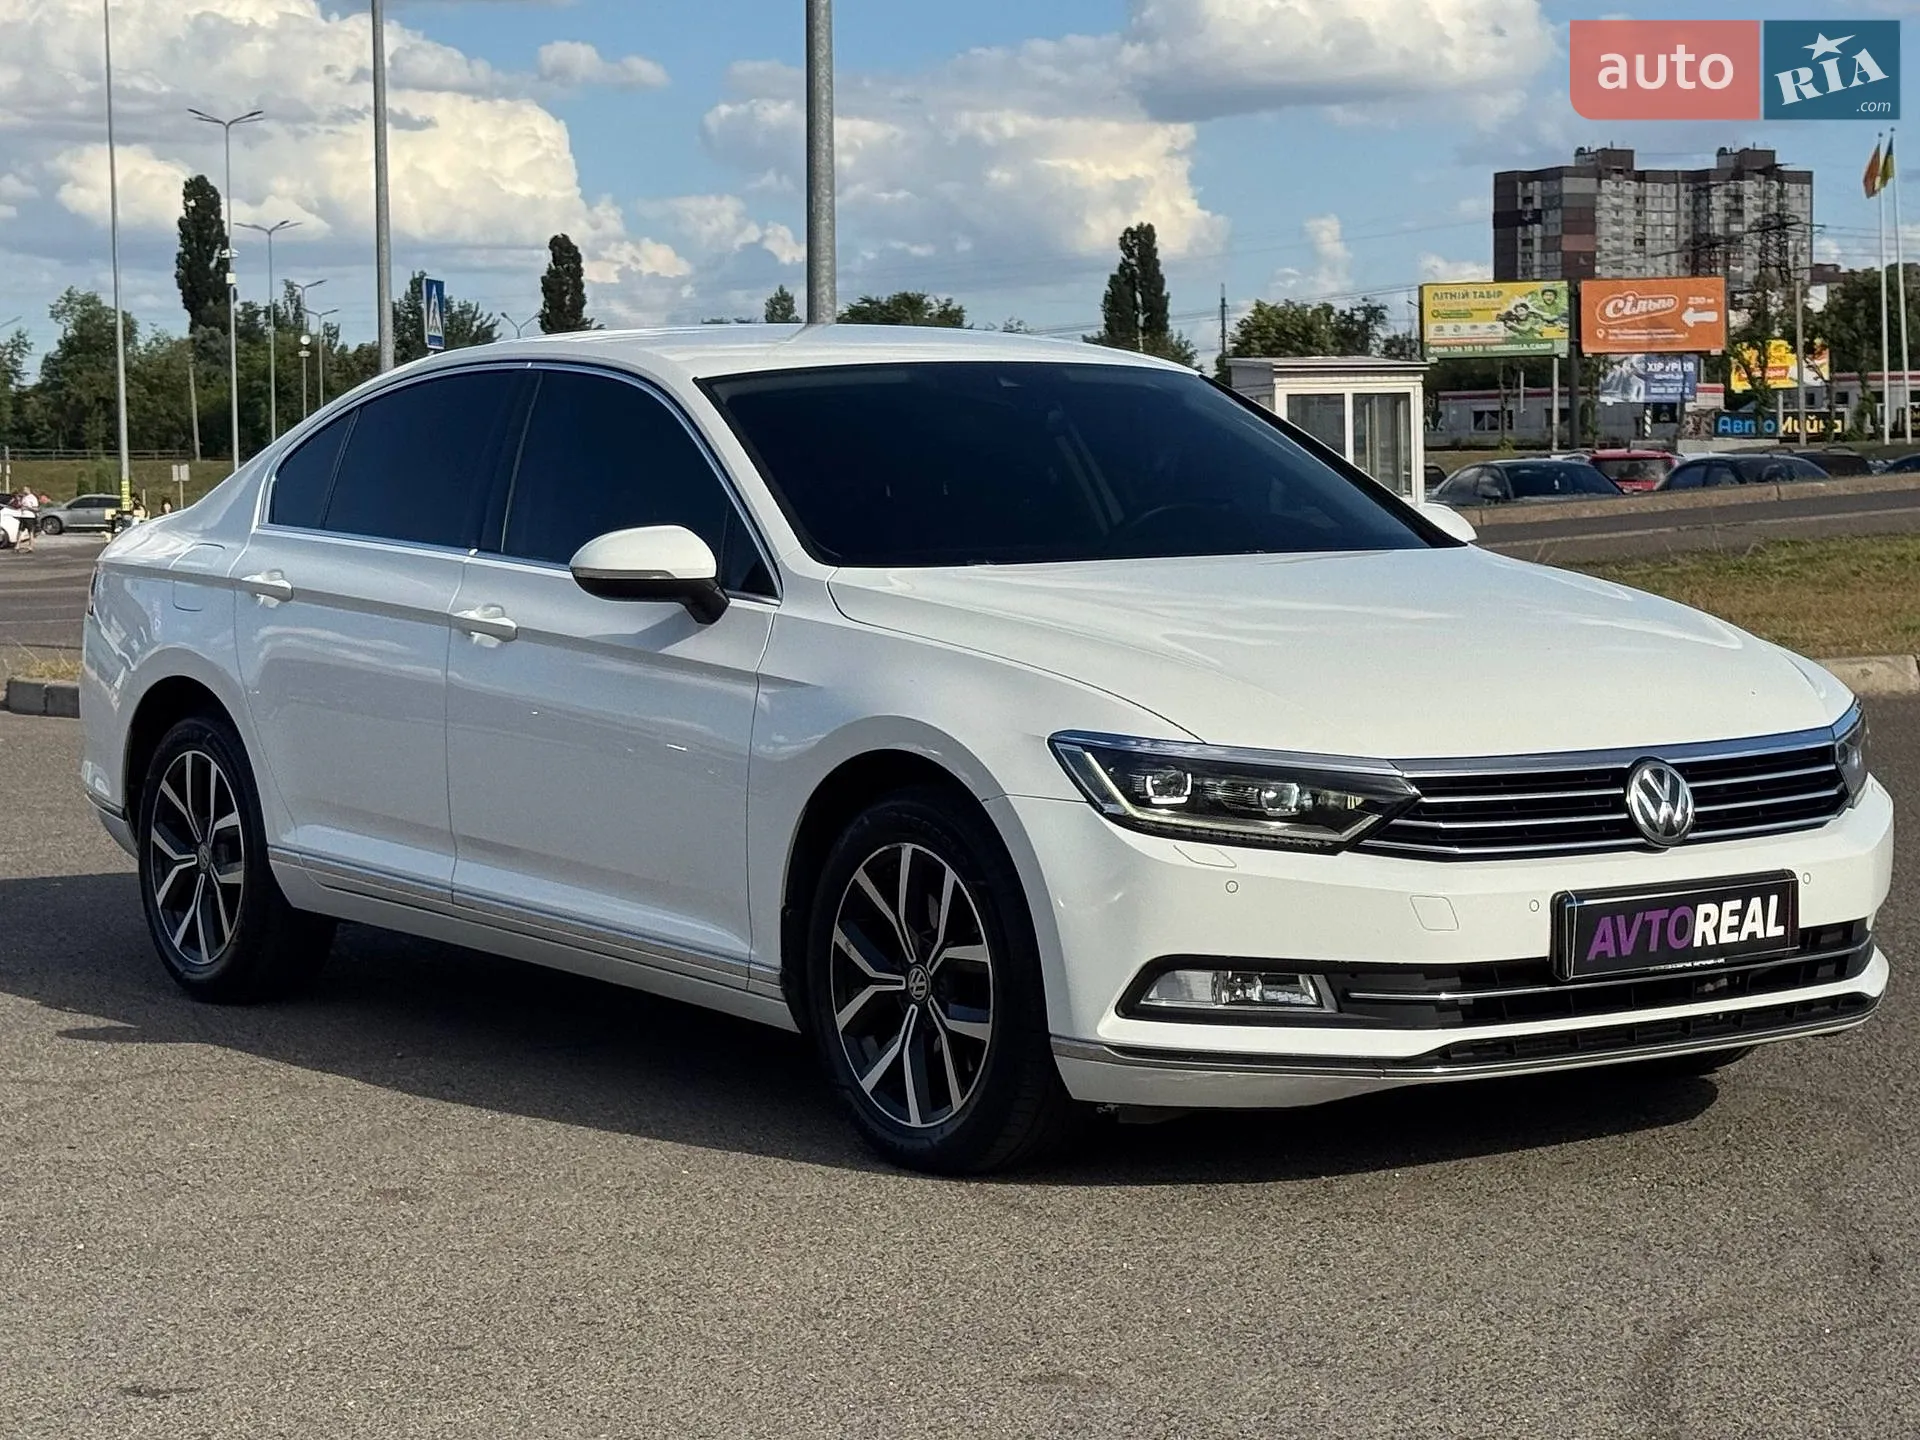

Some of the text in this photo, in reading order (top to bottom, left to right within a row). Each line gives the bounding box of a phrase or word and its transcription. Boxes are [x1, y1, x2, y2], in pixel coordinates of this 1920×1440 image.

[1472, 290, 1503, 300] ТАБІР
[1605, 295, 1675, 318] Сільпо
[1587, 894, 1785, 961] AVTOREAL
